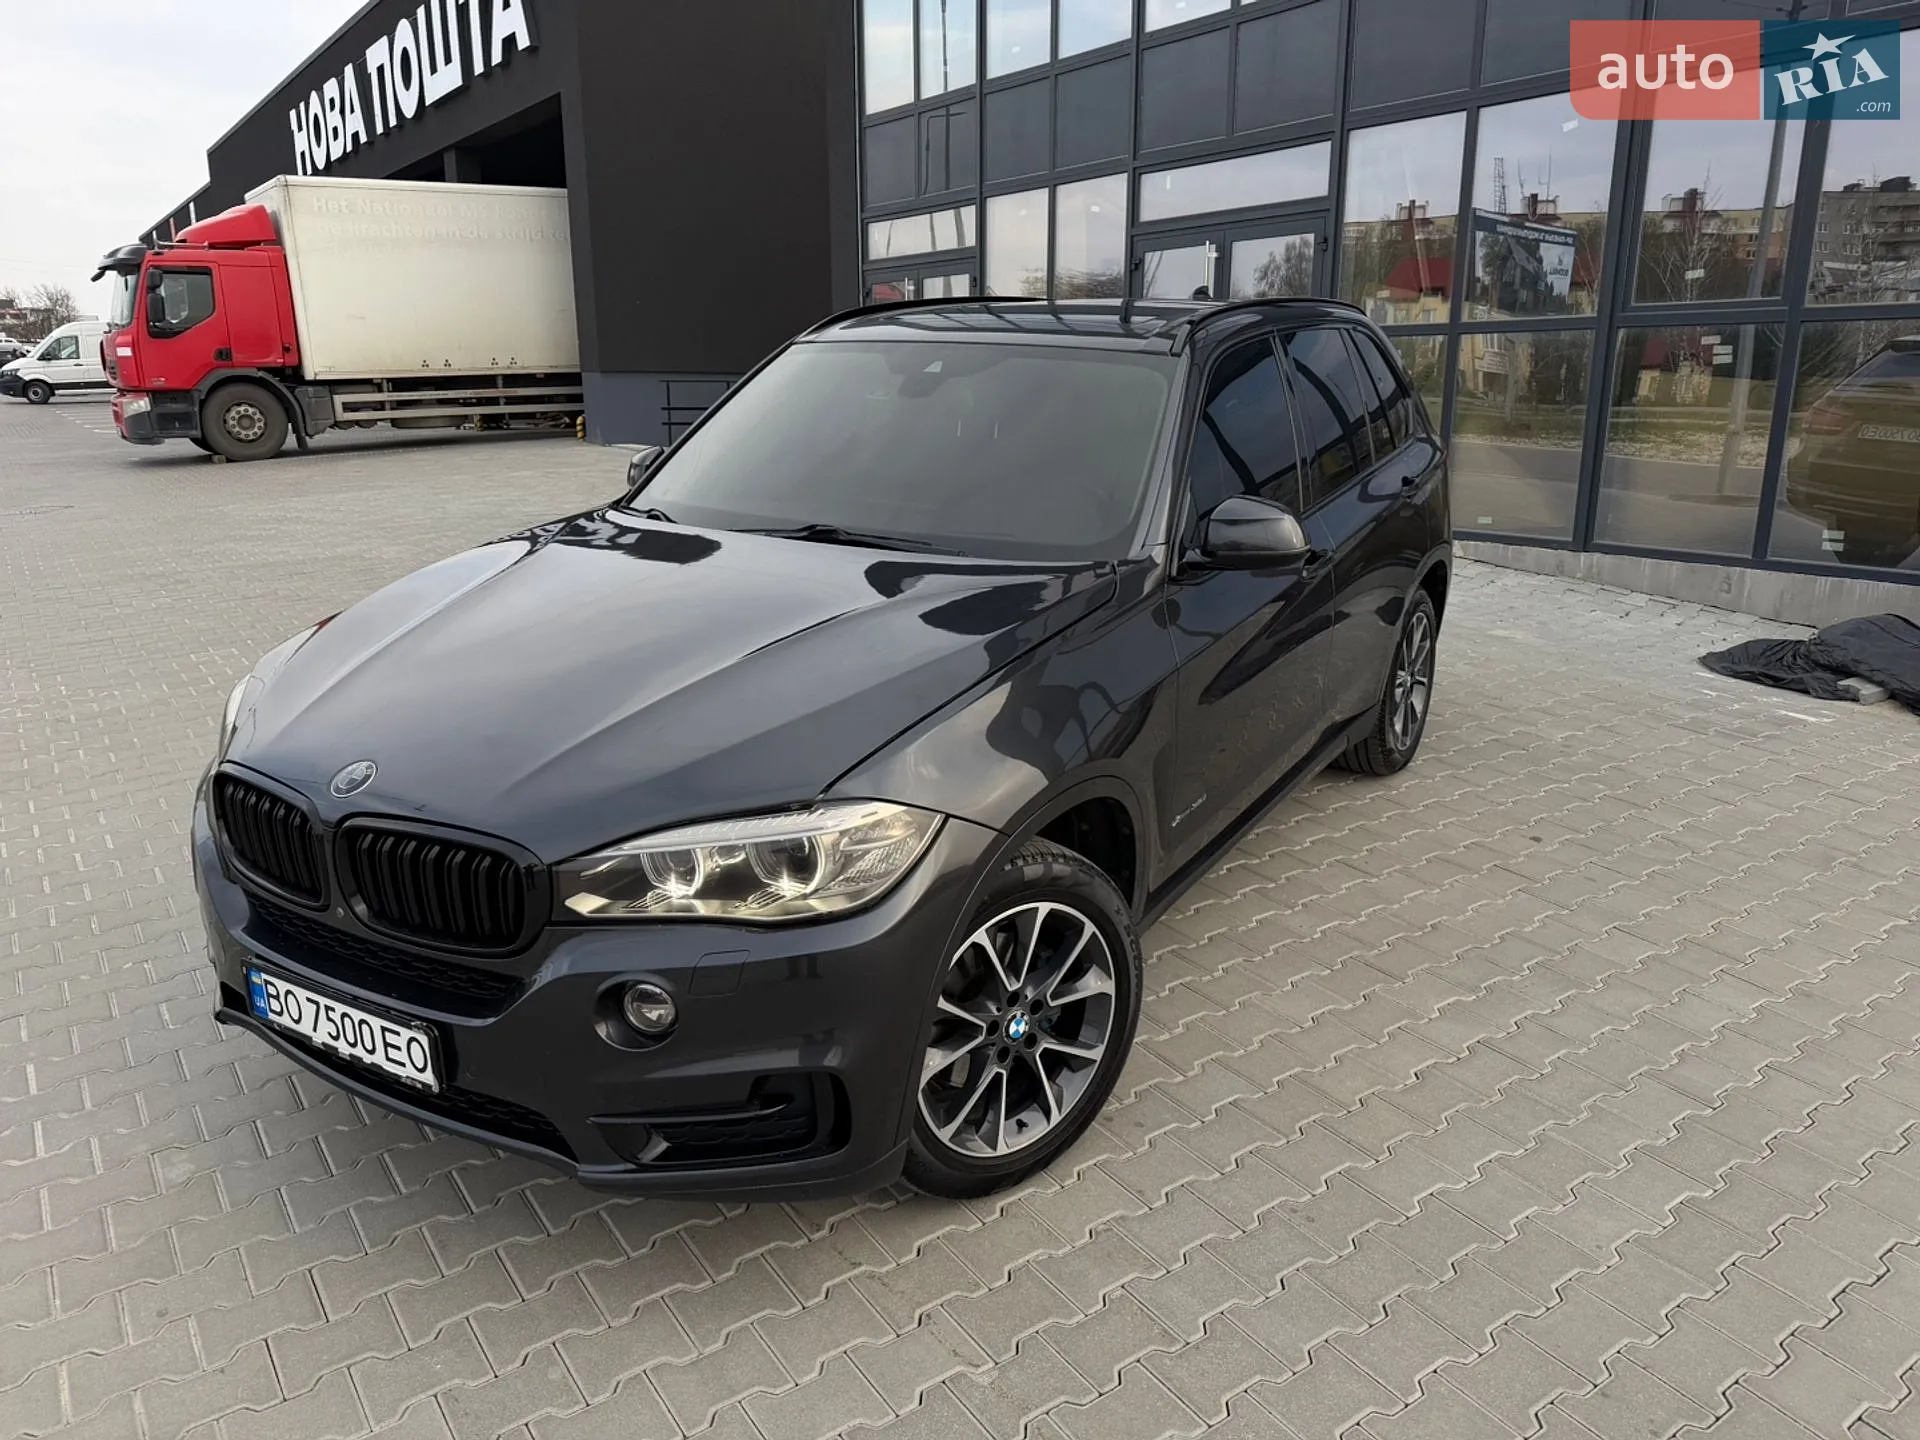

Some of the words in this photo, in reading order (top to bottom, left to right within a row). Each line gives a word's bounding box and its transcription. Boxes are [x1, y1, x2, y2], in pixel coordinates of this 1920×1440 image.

[289, 63, 367, 176] НОВА
[365, 0, 531, 135] ПОШТА
[254, 997, 266, 1007] UA
[263, 979, 302, 1025] BO
[305, 997, 377, 1055] 7500
[380, 1025, 428, 1073] EO
